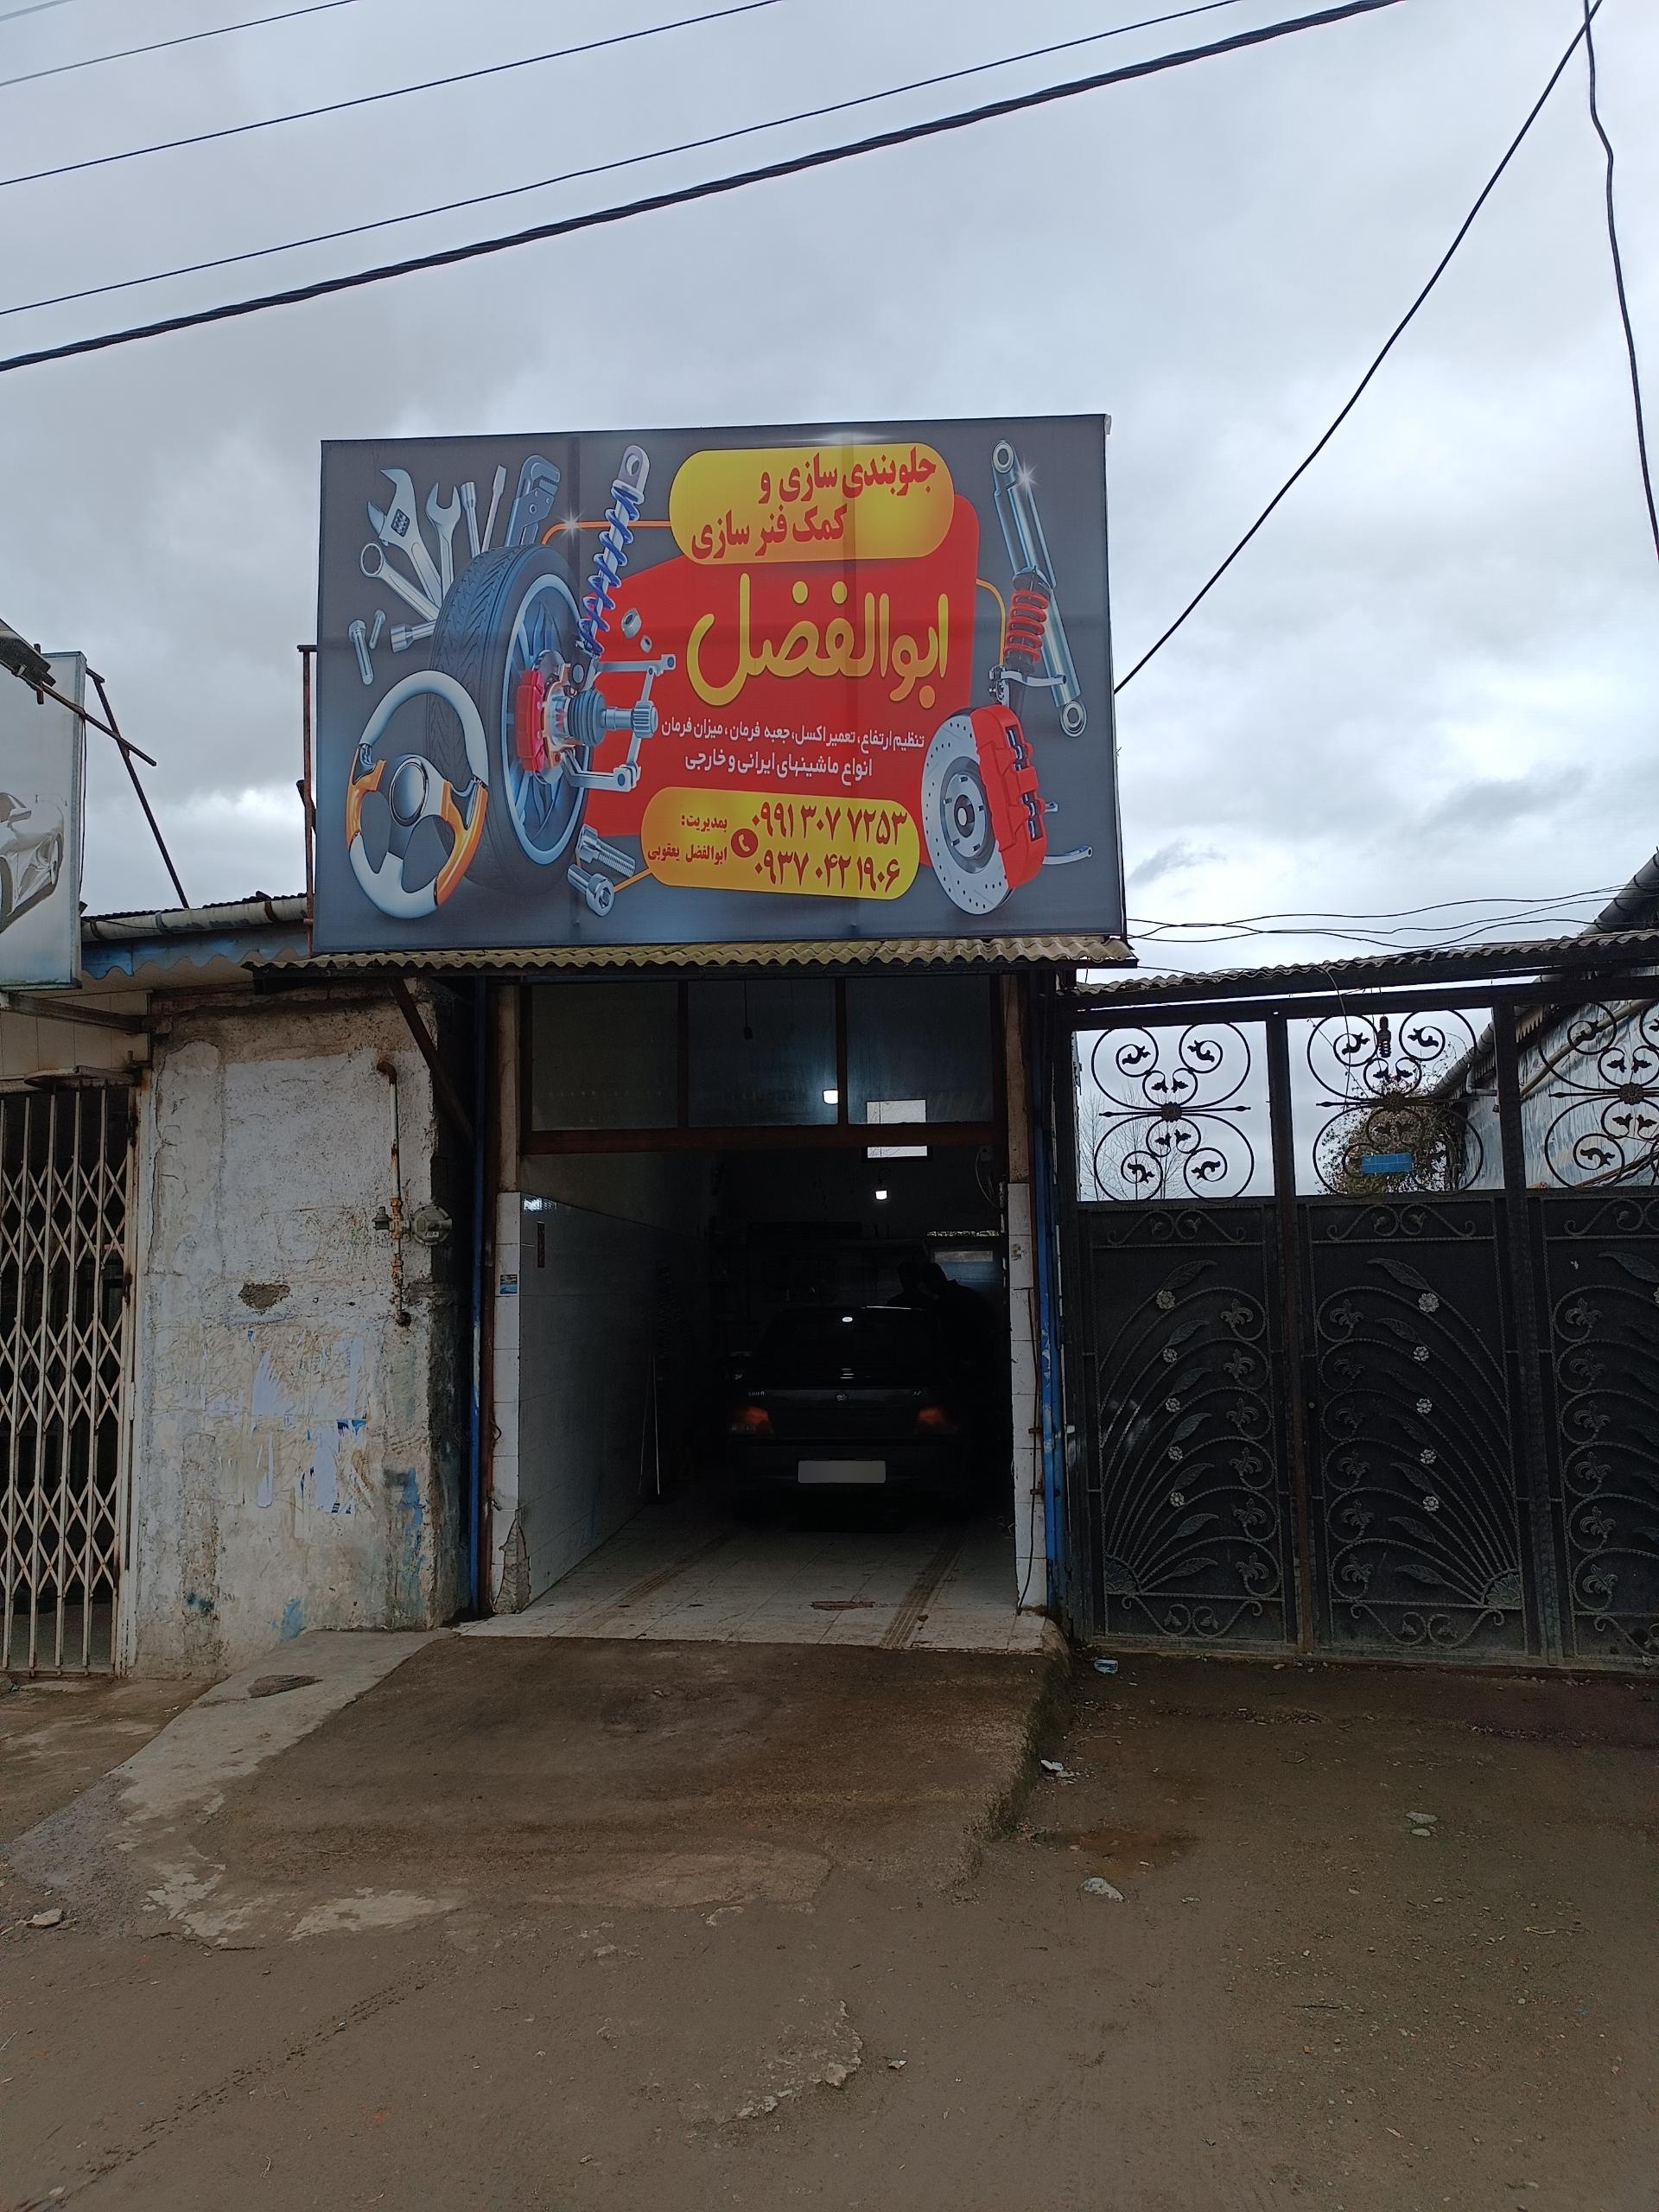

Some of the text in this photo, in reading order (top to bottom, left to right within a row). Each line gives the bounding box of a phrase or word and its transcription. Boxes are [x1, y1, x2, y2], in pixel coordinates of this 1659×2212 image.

[758, 447, 937, 504] جلوبندی سازی و
[691, 504, 848, 560] کمک فنر سازی
[687, 573, 949, 709] ابوالفضل
[661, 717, 692, 737] فرمان
[694, 719, 723, 737] میزان
[764, 728, 790, 744] جعبه
[826, 732, 855, 747] تعمیر
[893, 731, 925, 751] تنظیم
[685, 748, 873, 785] انواع ماشینهای ایرانی و خارجی
[648, 844, 728, 864] ابوالفضل یعقوبی
